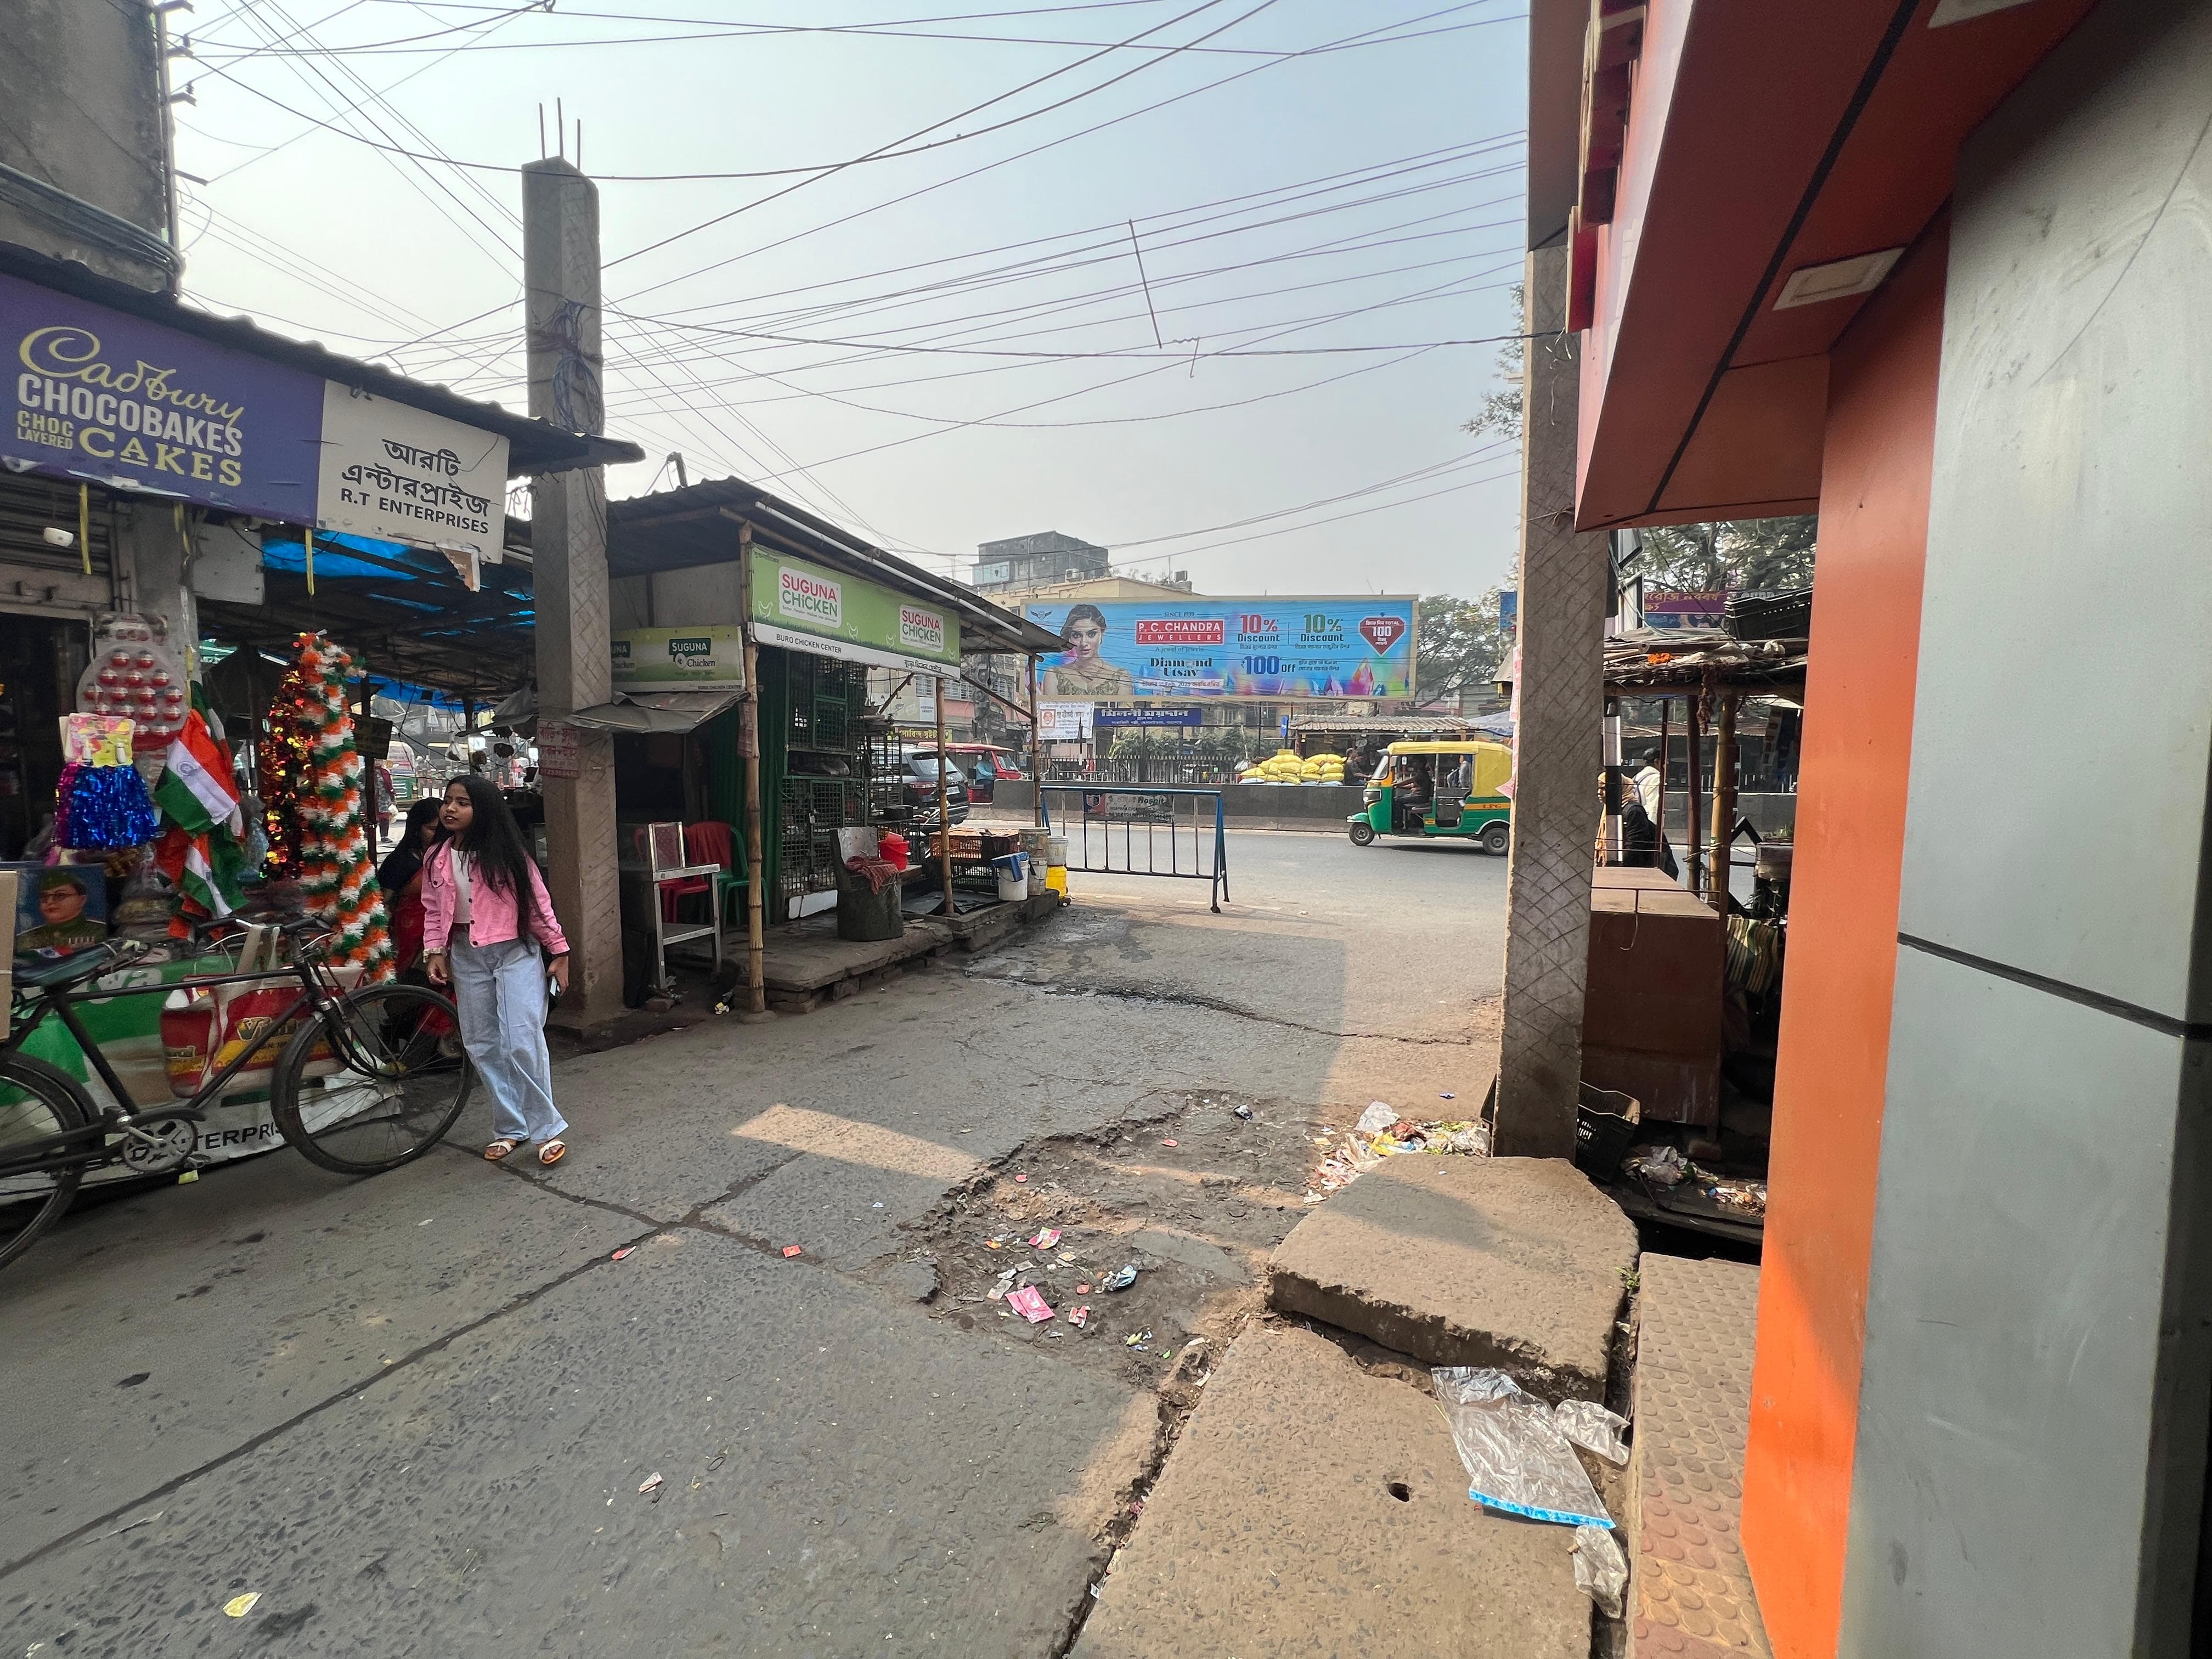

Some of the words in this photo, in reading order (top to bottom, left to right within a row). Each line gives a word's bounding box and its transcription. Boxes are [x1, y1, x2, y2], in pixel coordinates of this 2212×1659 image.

[19, 326, 245, 430] Cadbury
[17, 410, 74, 437] CHOC
[18, 373, 243, 456] CHOCOBAKES
[17, 426, 74, 450] LAYERED
[80, 427, 241, 487] CAKES
[382, 439, 461, 476] আরটি
[342, 462, 490, 517] এন্টারপ্রাইজ
[341, 488, 370, 506] R.T
[379, 496, 489, 534] ENTERPRISES
[782, 573, 837, 602] SUGUNA
[902, 610, 940, 630] SUGUNA
[1138, 623, 1147, 632] P.
[1150, 623, 1161, 632] C.
[1165, 622, 1221, 631] CHANDRA
[1238, 634, 1280, 642] Discount
[1300, 634, 1344, 642] Discount
[1372, 626, 1392, 637] 100
[672, 642, 708, 652] SUGUNA
[776, 633, 794, 644] BURO
[795, 637, 820, 649] CHICKEN
[821, 644, 842, 654] CENTER
[612, 660, 635, 669] hicken
[687, 658, 716, 667] Chicken
[1150, 657, 1212, 667] Diamond
[1164, 668, 1199, 676] Utsav
